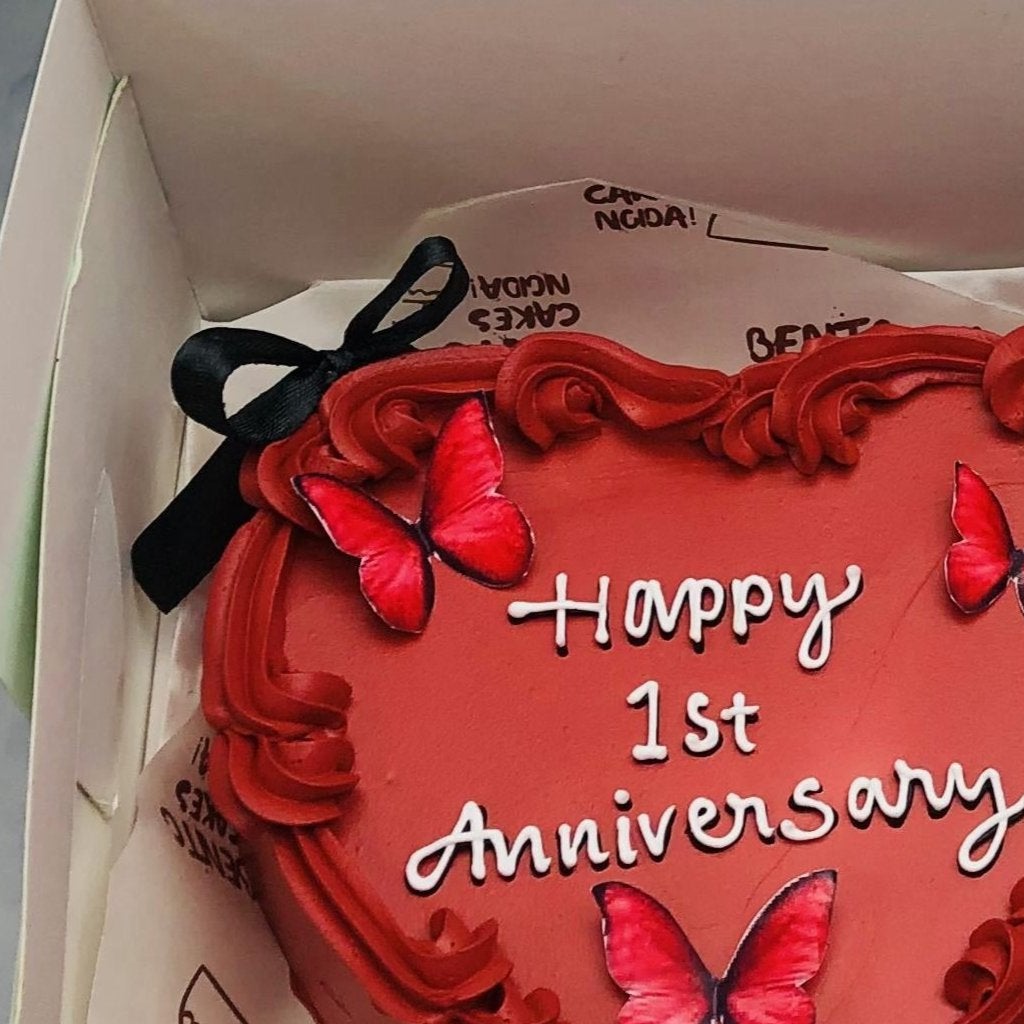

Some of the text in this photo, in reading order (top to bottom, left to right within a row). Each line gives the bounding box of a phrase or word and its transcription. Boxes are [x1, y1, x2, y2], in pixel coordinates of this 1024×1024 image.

[467, 301, 581, 333] CAKES
[507, 564, 863, 670] Happy
[626, 680, 761, 760] 1st
